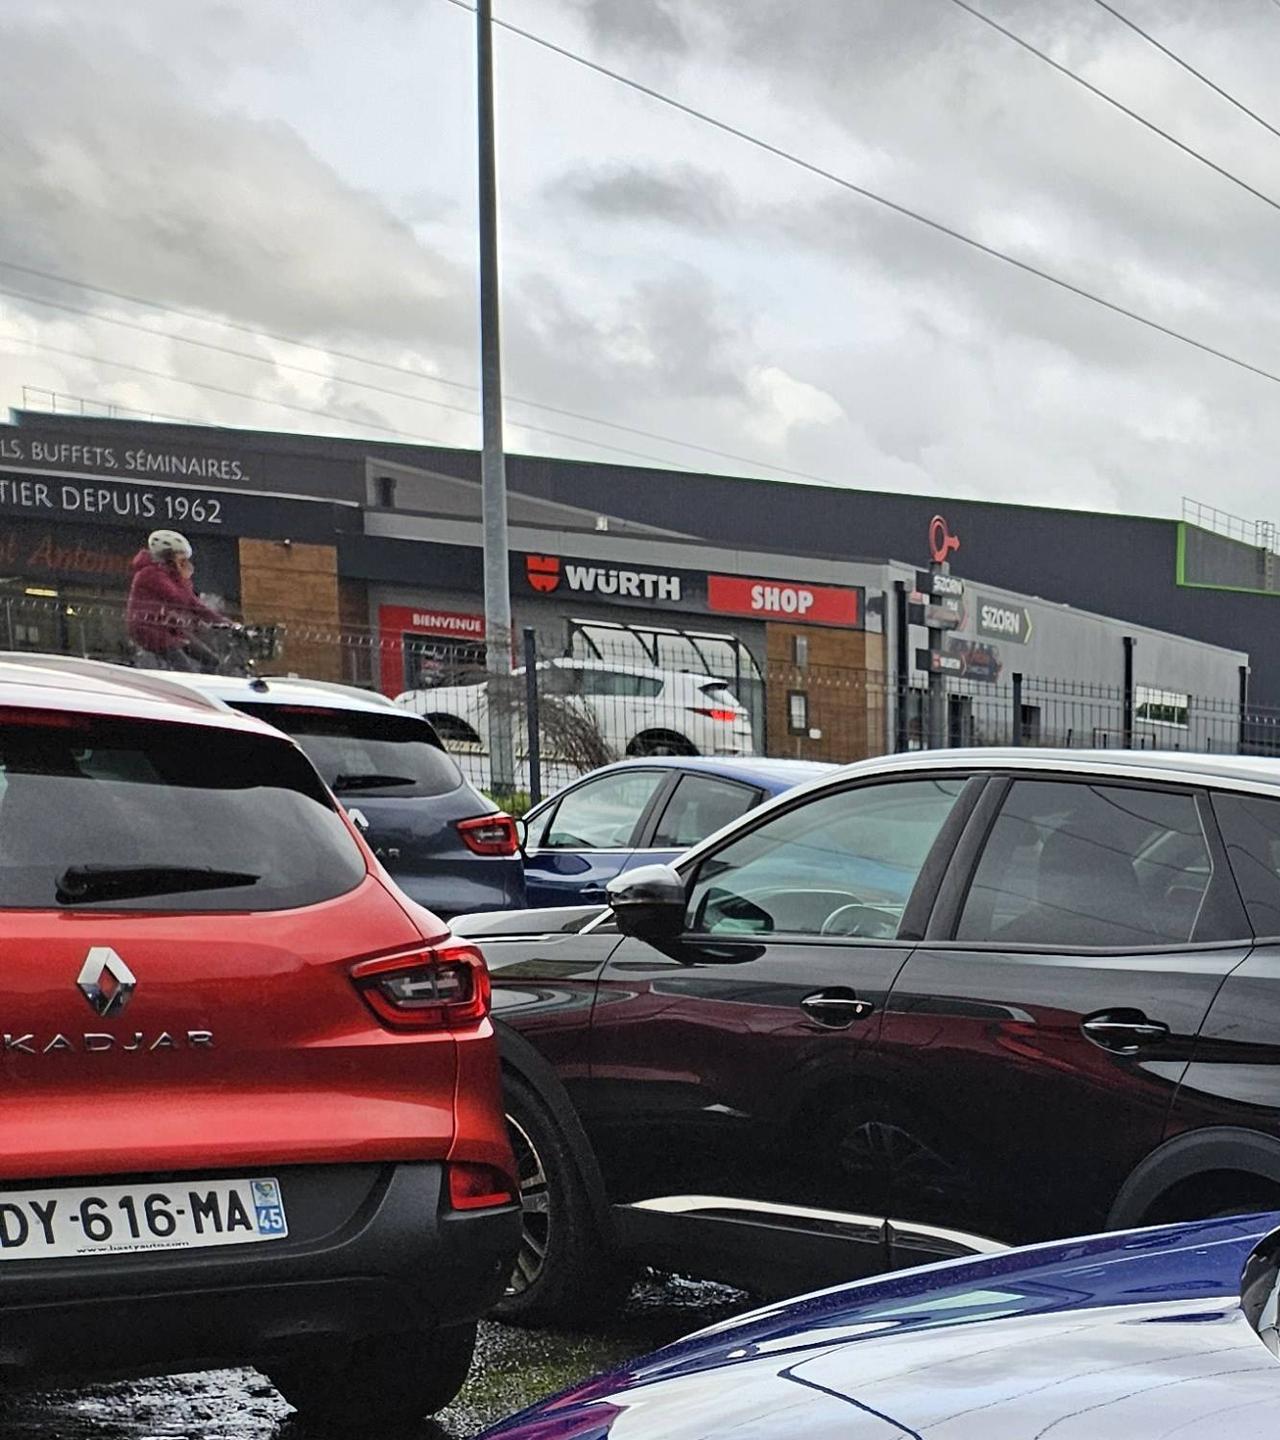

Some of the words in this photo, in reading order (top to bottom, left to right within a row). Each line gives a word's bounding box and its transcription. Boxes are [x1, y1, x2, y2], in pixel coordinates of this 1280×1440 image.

[32, 441, 119, 469] BUFFETS,
[62, 486, 155, 517] DEPUIS
[165, 496, 222, 523] 1962
[565, 565, 681, 601] WÜRTH
[750, 585, 814, 614] SHOP
[412, 613, 481, 633] BIENVENUE
[4, 1031, 213, 1053] KADJAR
[258, 1207, 283, 1230] 45
